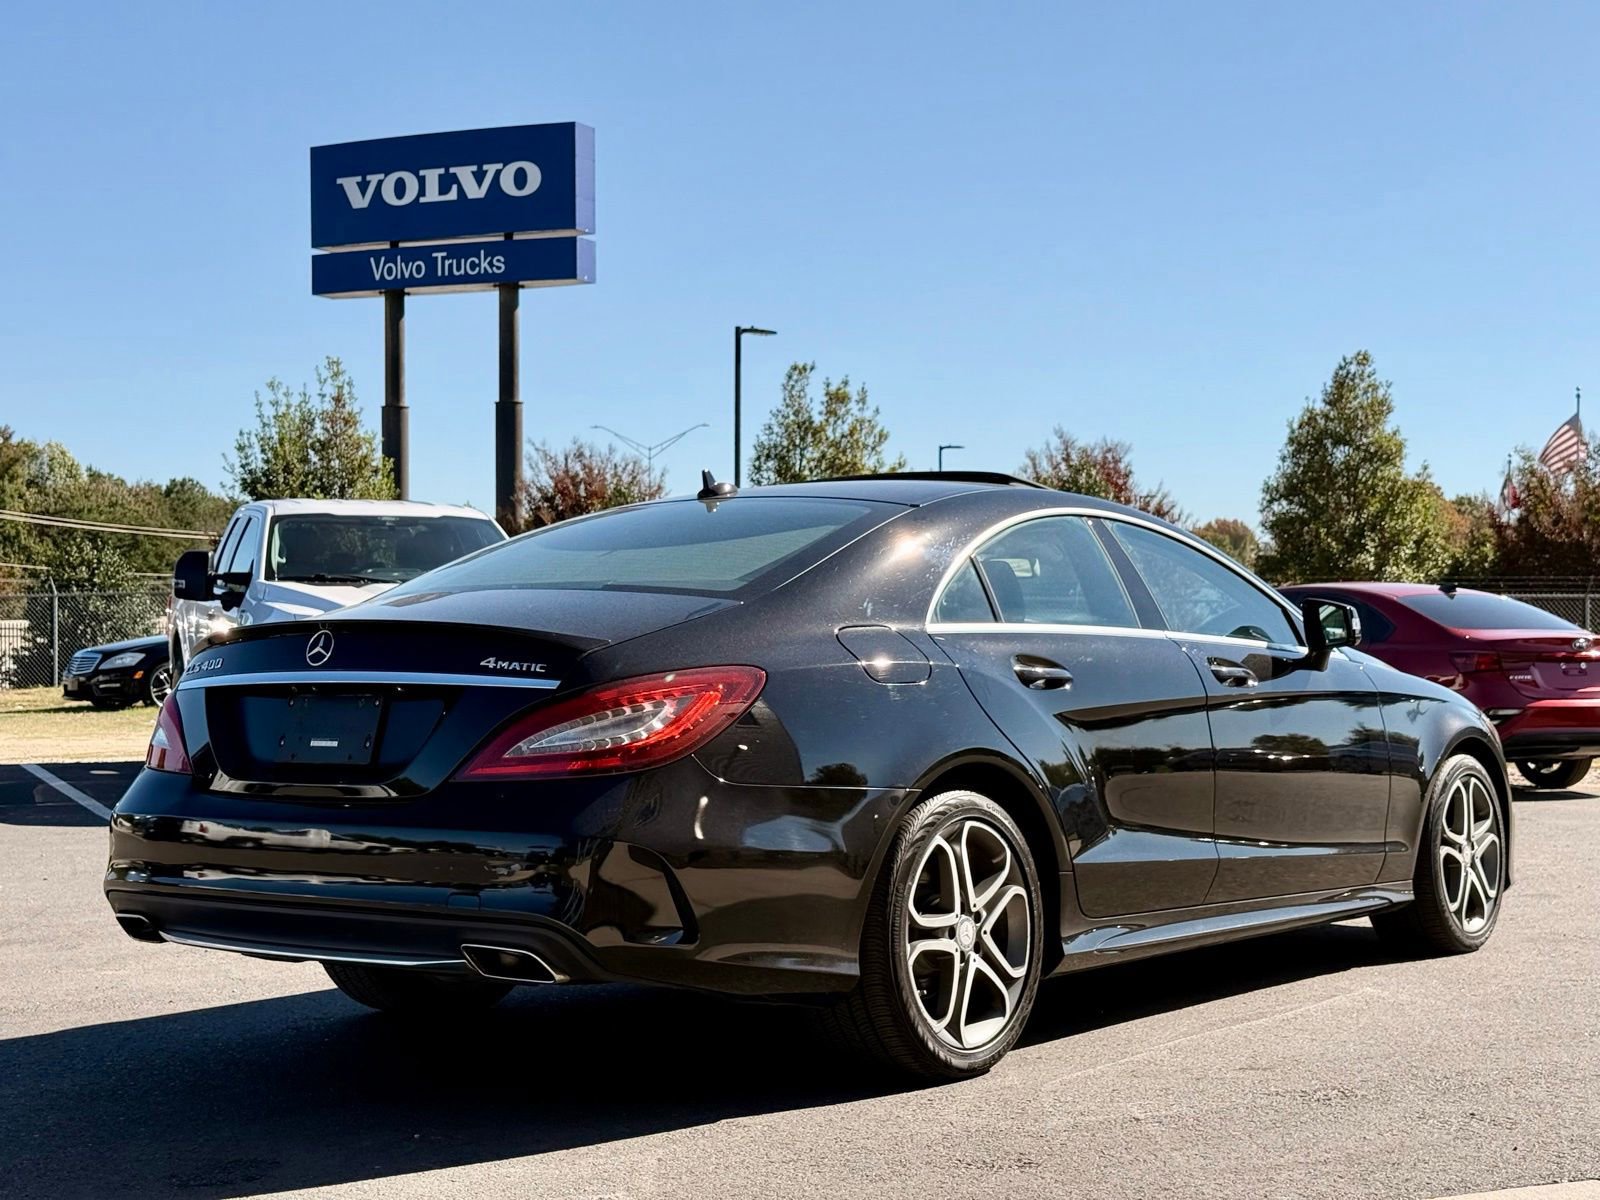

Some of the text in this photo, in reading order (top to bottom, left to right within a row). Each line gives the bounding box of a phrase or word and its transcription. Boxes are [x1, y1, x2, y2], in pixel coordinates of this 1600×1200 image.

[336, 160, 542, 209] VOLVO
[370, 249, 506, 281] Volvo Trucks
[480, 656, 547, 672] 4MATIC
